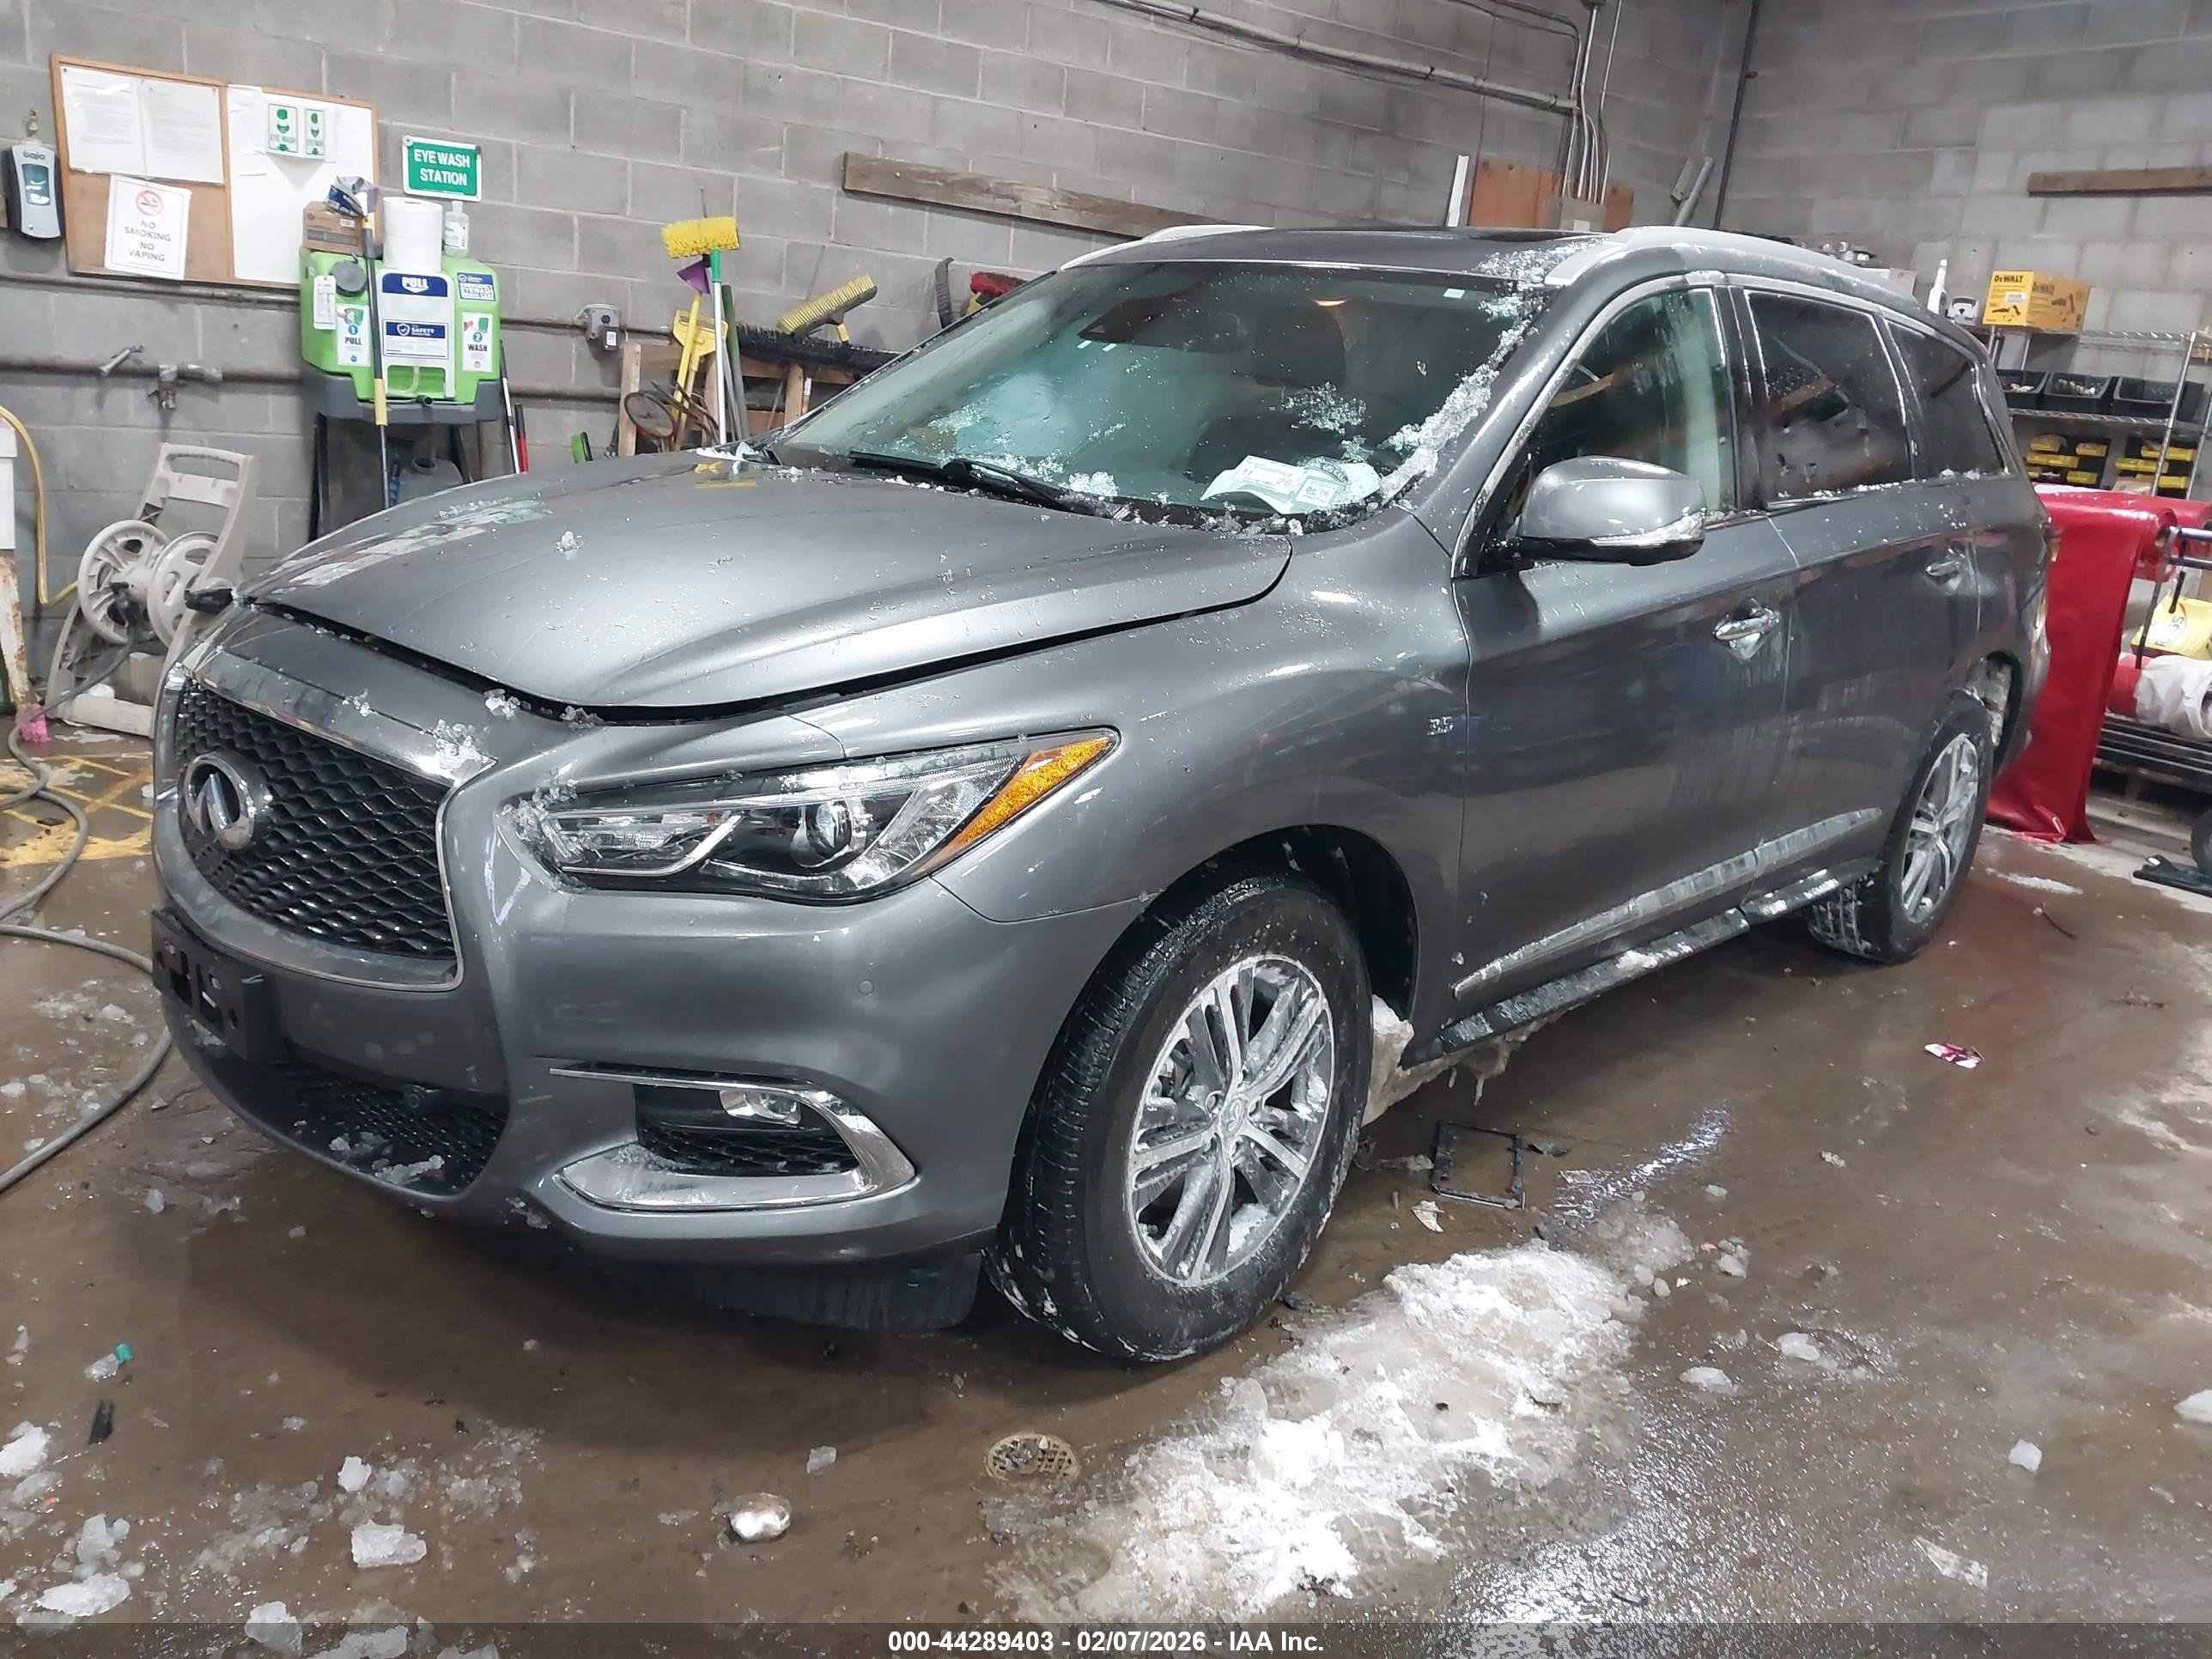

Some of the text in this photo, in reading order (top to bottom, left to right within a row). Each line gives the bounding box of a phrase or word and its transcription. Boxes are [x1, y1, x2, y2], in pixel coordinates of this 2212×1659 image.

[414, 149, 471, 167] EYE WASH
[420, 167, 467, 185] STATION
[141, 220, 156, 229] NO
[125, 227, 171, 241] SMOKING
[140, 241, 155, 251] NO
[129, 249, 165, 262] VAPING
[401, 276, 428, 287] PULL
[345, 337, 362, 345] PULL
